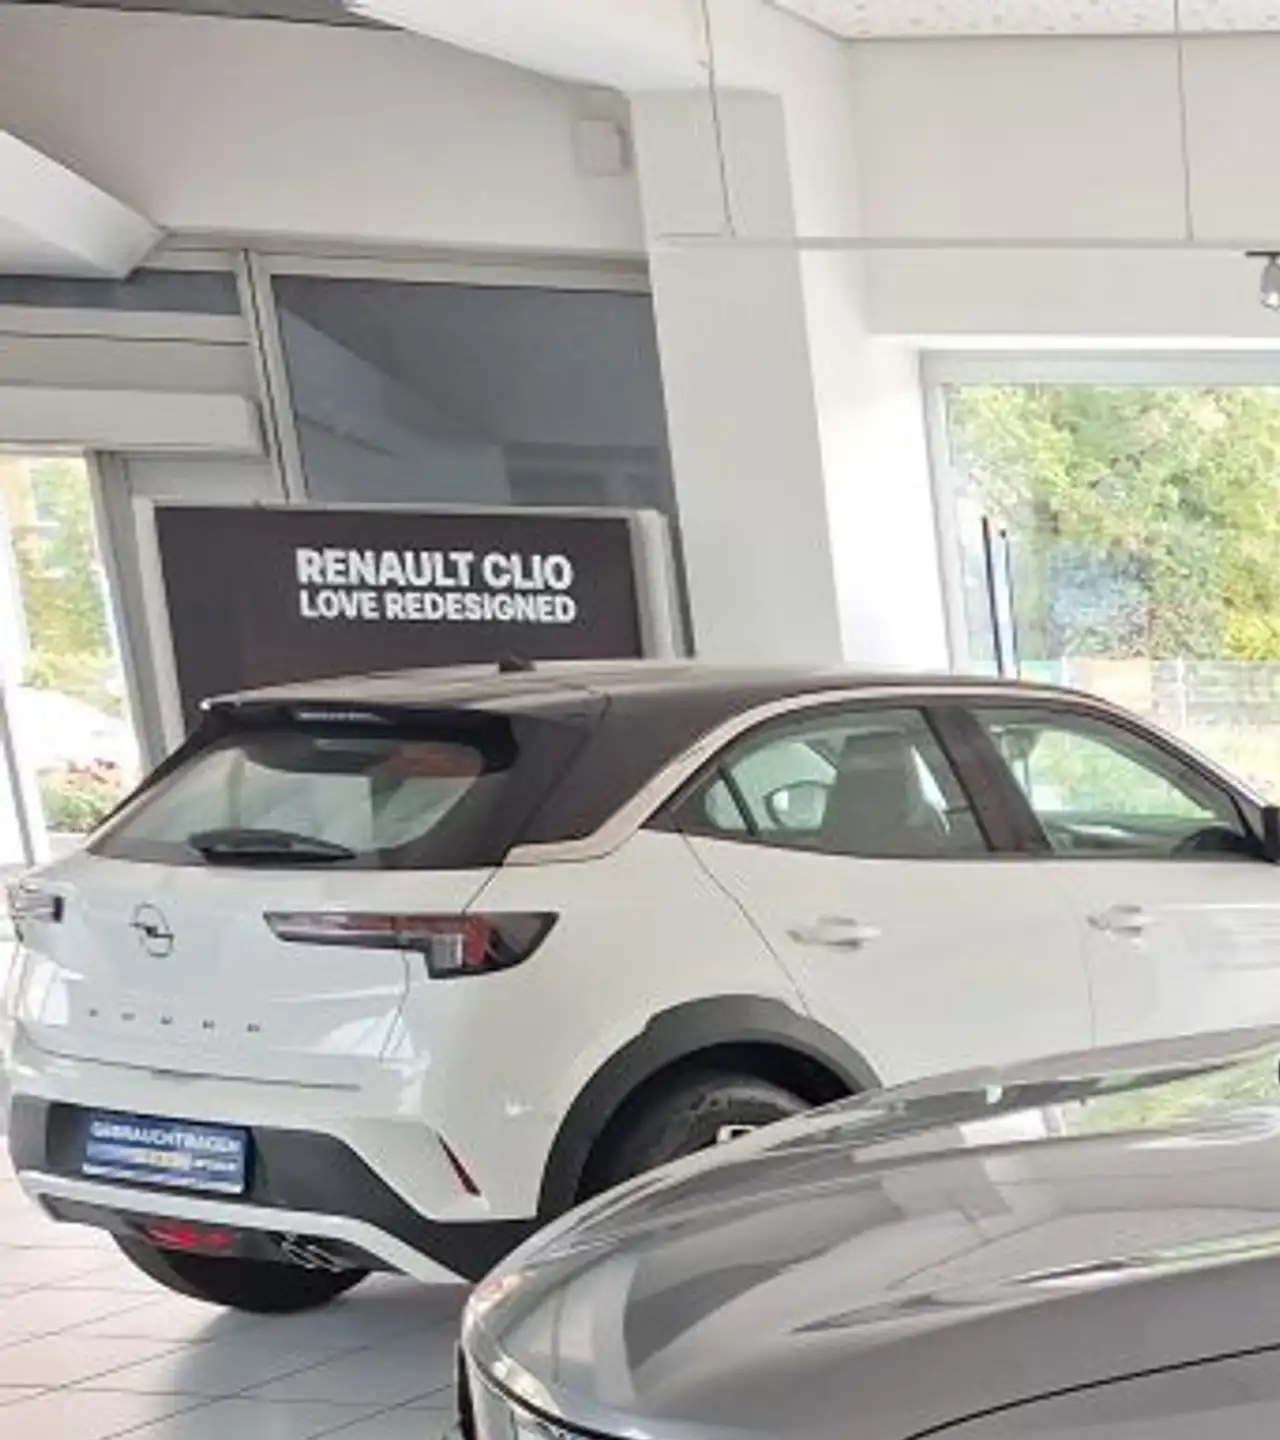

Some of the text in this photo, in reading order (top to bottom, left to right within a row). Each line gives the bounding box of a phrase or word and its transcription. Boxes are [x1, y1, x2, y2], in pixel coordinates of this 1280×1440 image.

[296, 547, 574, 590] RENAULT CLIO
[300, 589, 577, 623] LOVE REDESIGNED
